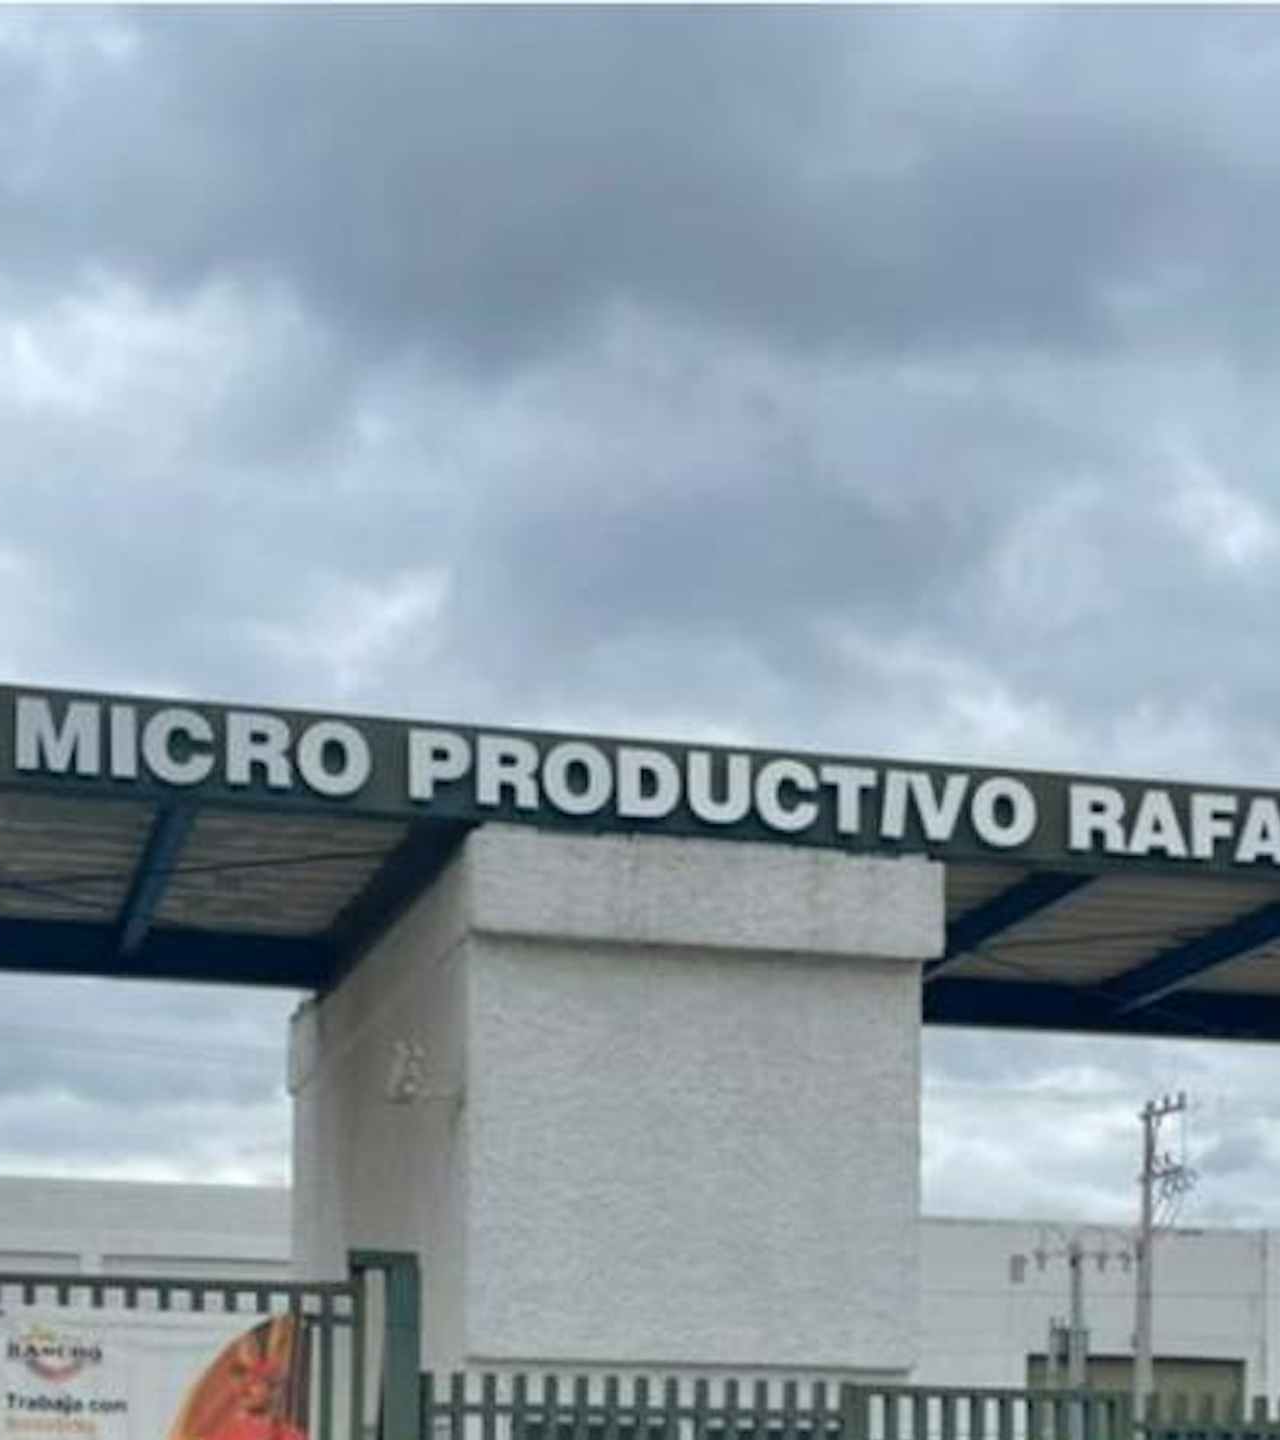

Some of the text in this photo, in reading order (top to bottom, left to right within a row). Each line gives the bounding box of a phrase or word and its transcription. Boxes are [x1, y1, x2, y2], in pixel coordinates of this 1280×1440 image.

[16, 696, 371, 796] MICRO
[408, 728, 1037, 847] PRODUCTIVO
[7, 1393, 128, 1414] Trabaja con
